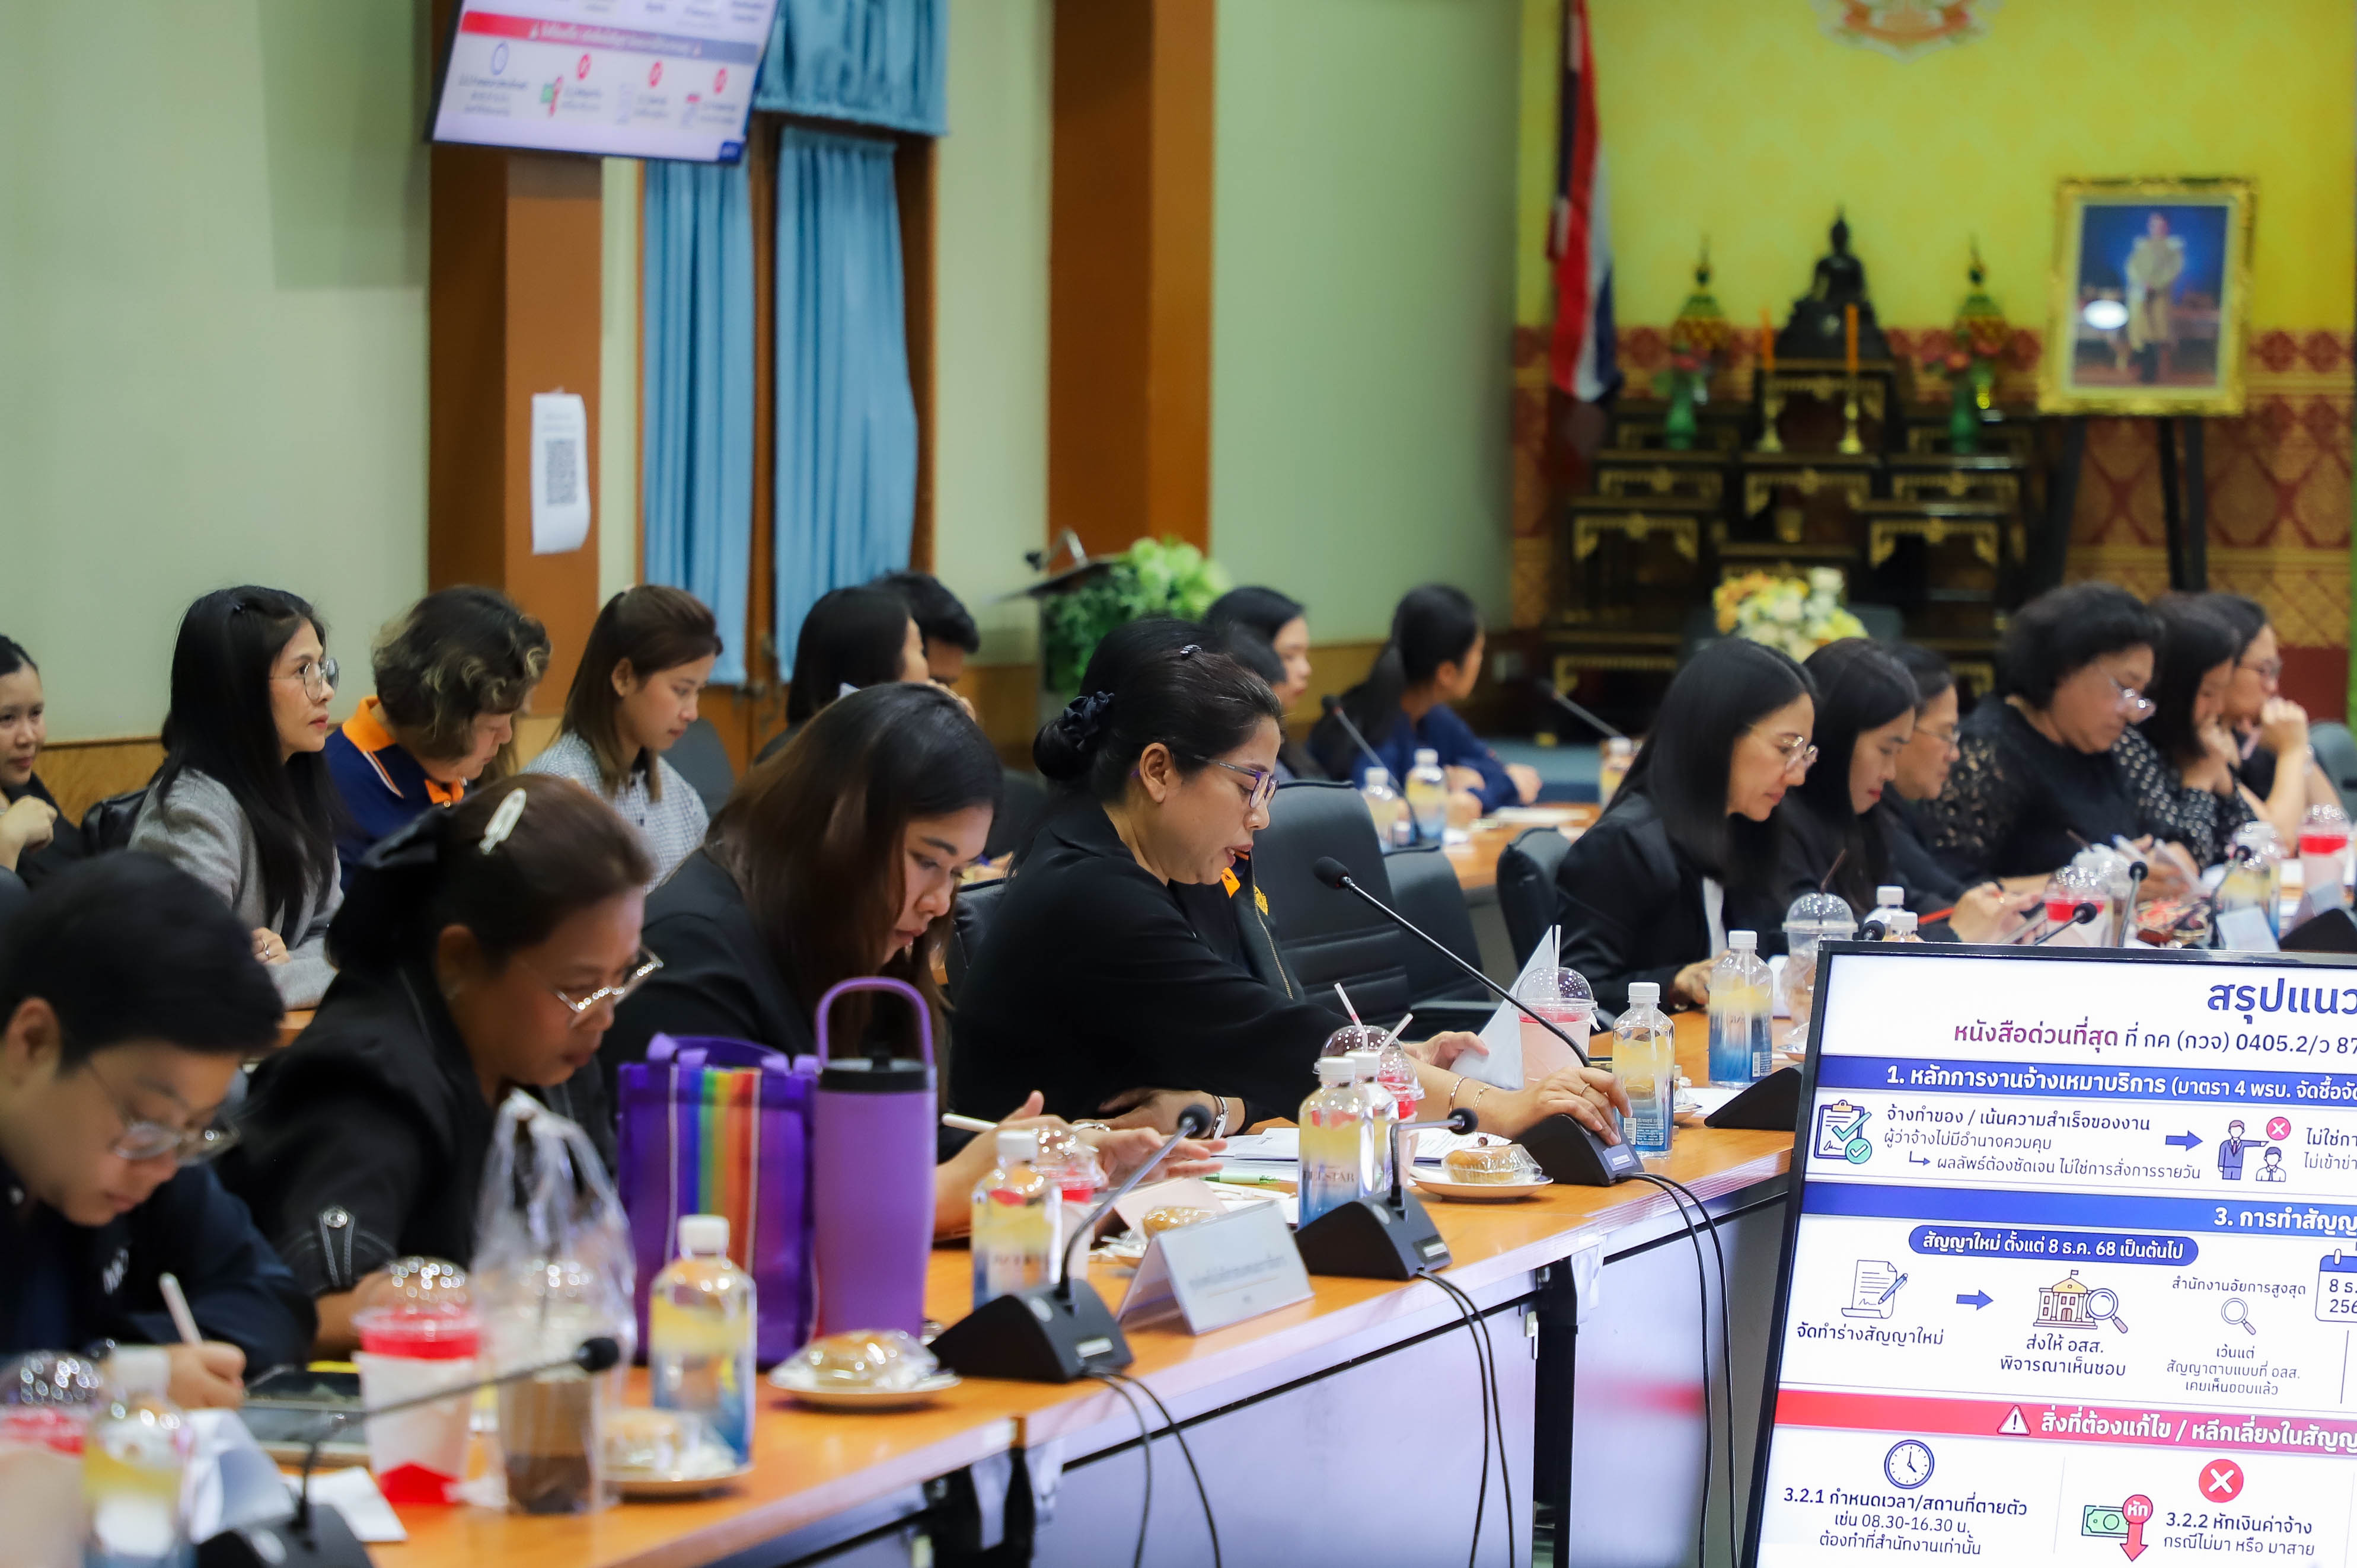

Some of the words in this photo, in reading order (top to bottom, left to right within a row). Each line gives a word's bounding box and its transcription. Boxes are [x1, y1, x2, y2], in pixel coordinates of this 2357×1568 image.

[1954, 1015, 2118, 1053] หนังสือด่วนที่สุด
[2125, 1021, 2139, 1047] ที่
[2144, 1034, 2170, 1048] กค
[2177, 1030, 2230, 1053] (กวจ)
[2236, 1033, 2330, 1056] 0405.2/ว
[1887, 1065, 1905, 1084] 1.
[1911, 1064, 2166, 1093] หลักการงานจ้างเหมาบริการ
[2171, 1076, 2230, 1096] (มาตรา
[2234, 1080, 2246, 1096] 4
[2251, 1083, 2291, 1098] พรบ.
[1980, 1107, 2150, 1131] เน้นความสำเร็จของงาน
[1884, 1127, 2052, 1154] ผู้ว่าจ้างไม่มีอำนาจควบคุม
[1937, 1155, 2055, 1173] ผลลัพธ์ต้องชัดเจน
[2059, 1157, 2200, 1179] ไม่ใช่การสั่งการรายวัน
[2214, 1207, 2233, 1226] 3.
[1923, 1231, 2001, 1253] สัญญาใหม่
[2004, 1230, 2045, 1253] ตั้งแต่
[2048, 1238, 2059, 1253] 8
[2062, 1242, 2091, 1255] ธ.ค.
[2096, 1241, 2116, 1256] 68
[2120, 1238, 2183, 1259] เป็นต้นไป
[2172, 1275, 2306, 1299] สำนักงานอัยการสูงสุด
[2329, 1278, 2339, 1293] 8
[1797, 1321, 1944, 1347] จัดทำร่างสัญญาใหม่
[2026, 1333, 2065, 1351] ส่งให้
[2068, 1340, 2104, 1353] อสส.
[2216, 1343, 2255, 1359] เว้นแต่
[2000, 1355, 2126, 1376] พิจารณาเห็นชอบ
[2041, 1404, 2171, 1438] สิ่งที่ต้องแก้ไข
[2175, 1419, 2187, 1442] /
[1784, 1487, 1825, 1504] 3.2.1
[1830, 1487, 2027, 1516] กำหนดเวลา/สถานที่ตายตัว
[2127, 1500, 2148, 1517] หัก
[1835, 1510, 1858, 1527] เช่น
[1862, 1513, 1953, 1532] 08.30-16.30
[1957, 1522, 1970, 1534] น.
[2165, 1512, 2208, 1529] 3.2.2
[2213, 1512, 2313, 1534] หักเงินค่าจ้าง
[1820, 1528, 1981, 1555] ต้องทำที่สำนักงานเท่านั้น
[2164, 1532, 2231, 1551] กรณีไม่มา
[2235, 1537, 2263, 1553] หรือ
[2268, 1543, 2315, 1556] มาสาย
